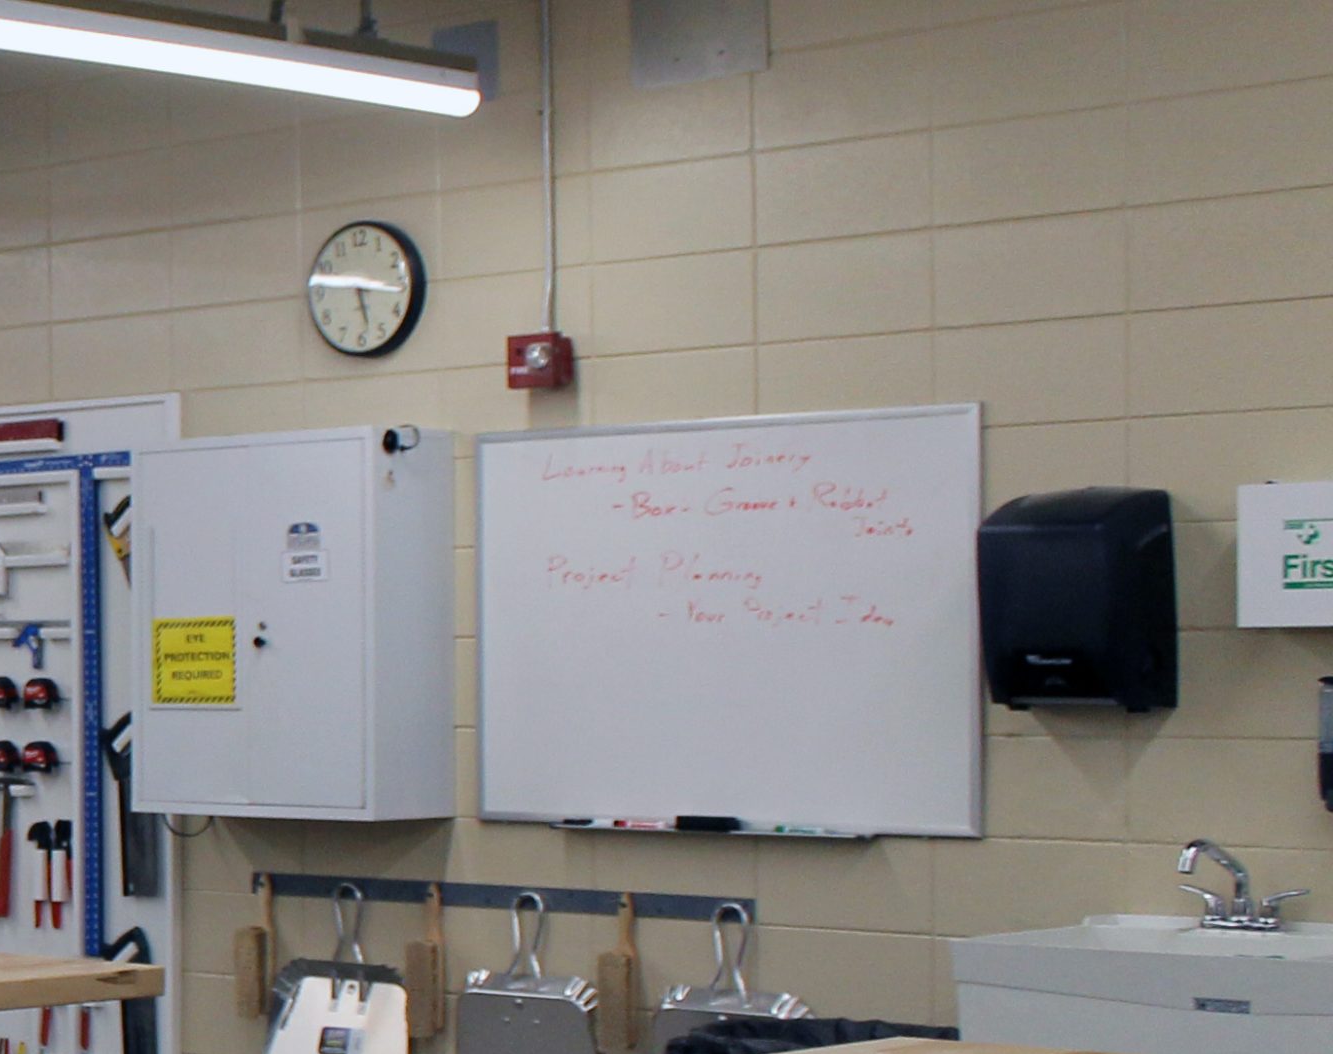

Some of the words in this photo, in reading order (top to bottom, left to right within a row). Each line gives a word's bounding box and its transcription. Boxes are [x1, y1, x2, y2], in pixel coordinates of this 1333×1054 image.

[353, 229, 367, 247] 12
[391, 251, 400, 268] 2
[392, 302, 400, 317] 4
[338, 326, 347, 343] 7
[377, 322, 386, 339] 5
[357, 333, 366, 347] 6
[542, 453, 626, 483] Learning
[638, 449, 709, 475] About
[726, 442, 812, 472] Joinery
[547, 554, 637, 590] Project
[659, 551, 763, 590] Planning
[688, 599, 725, 622] Your
[186, 633, 205, 643] EYE
[164, 652, 230, 662] PROTECTION
[172, 670, 223, 681] REQUIRED
